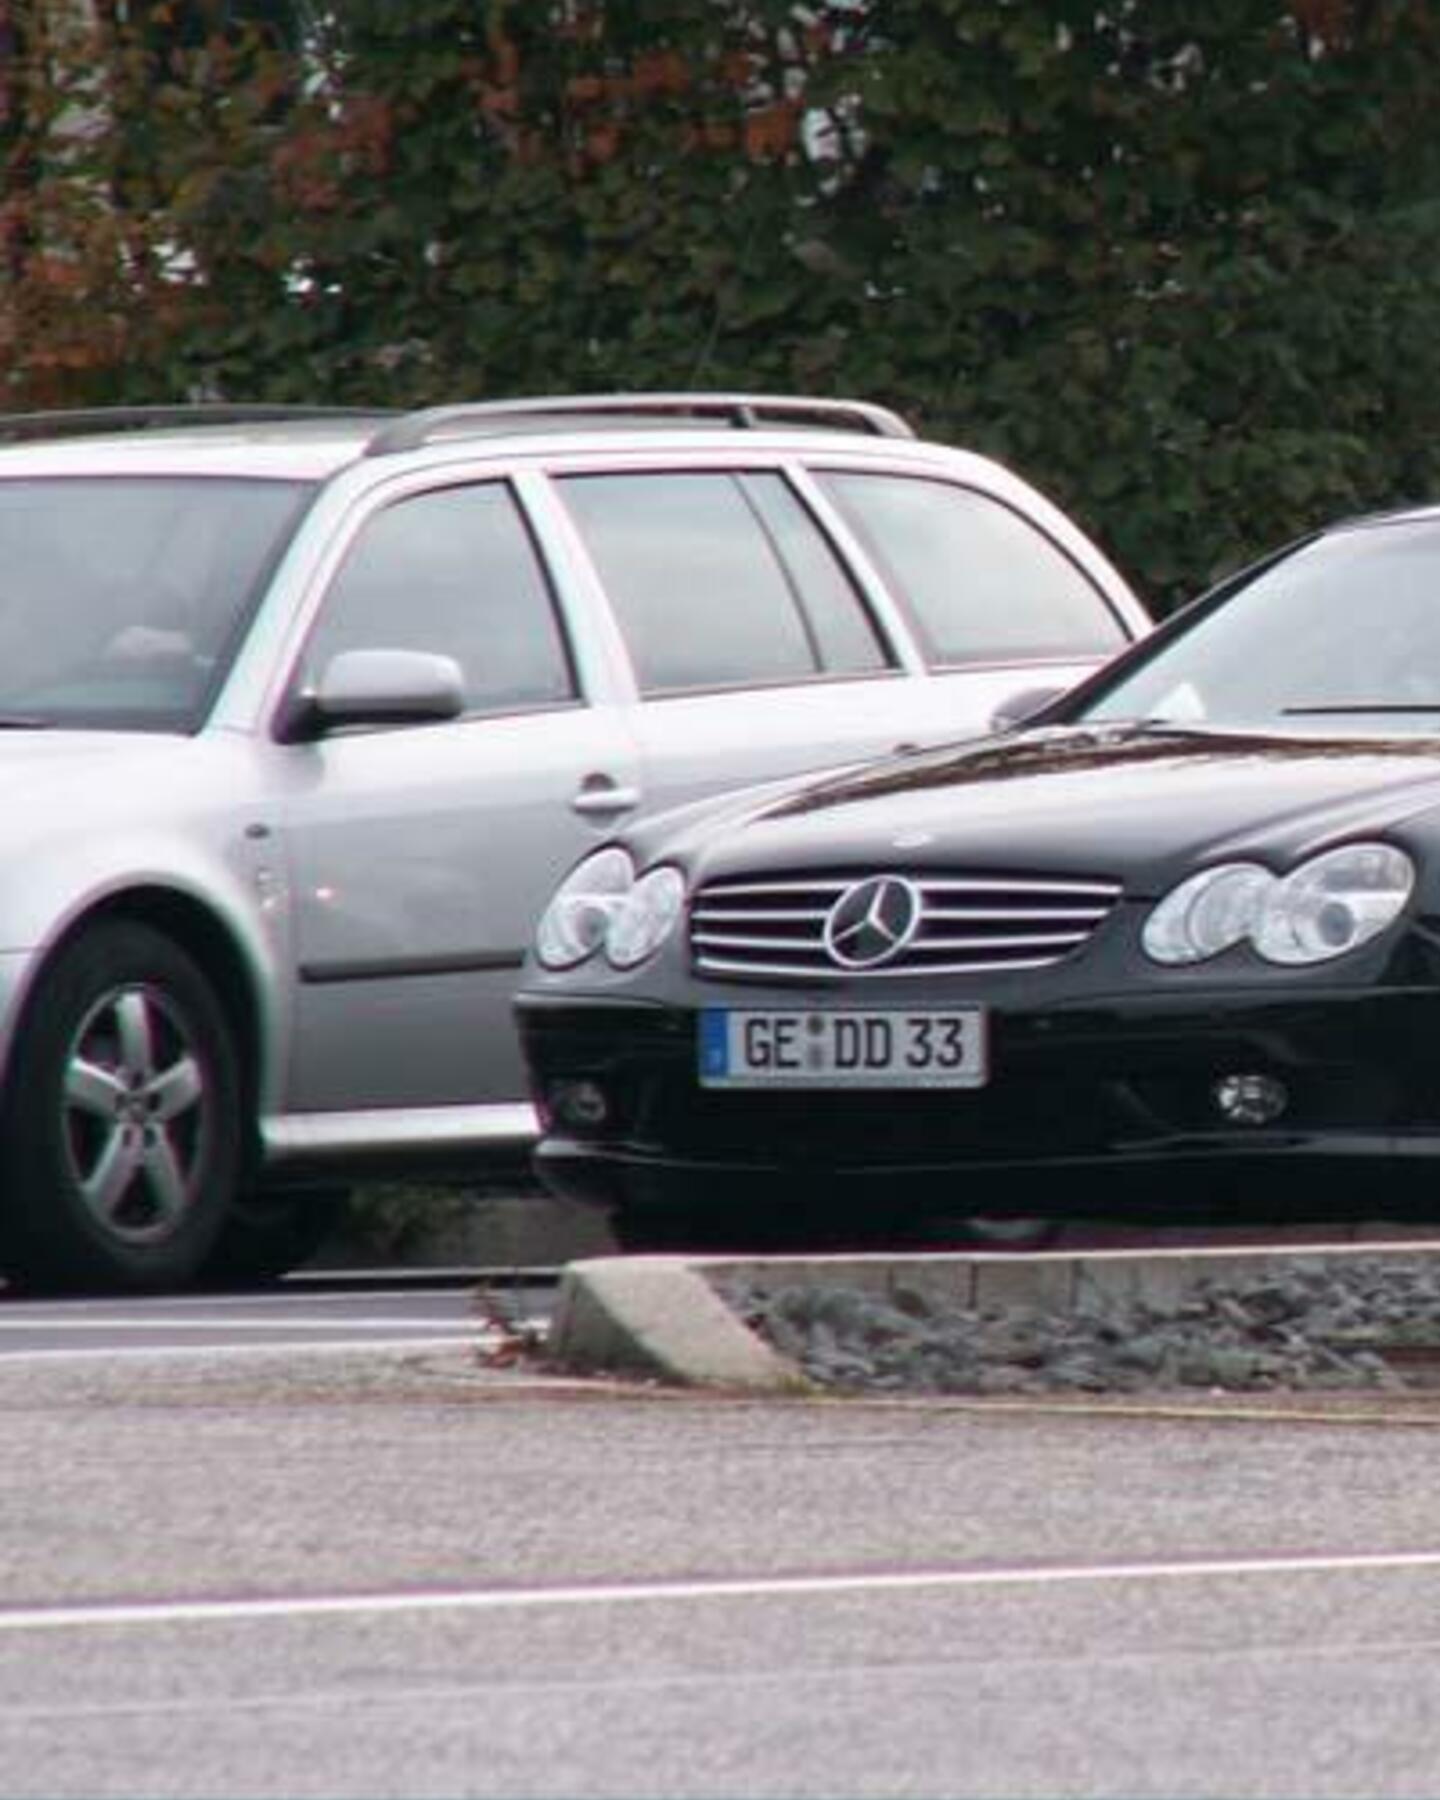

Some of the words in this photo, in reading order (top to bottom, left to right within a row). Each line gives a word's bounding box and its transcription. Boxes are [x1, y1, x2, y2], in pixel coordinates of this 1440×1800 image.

[745, 1018, 799, 1068] GE
[834, 1018, 893, 1068] DD
[905, 1018, 963, 1068] 33
